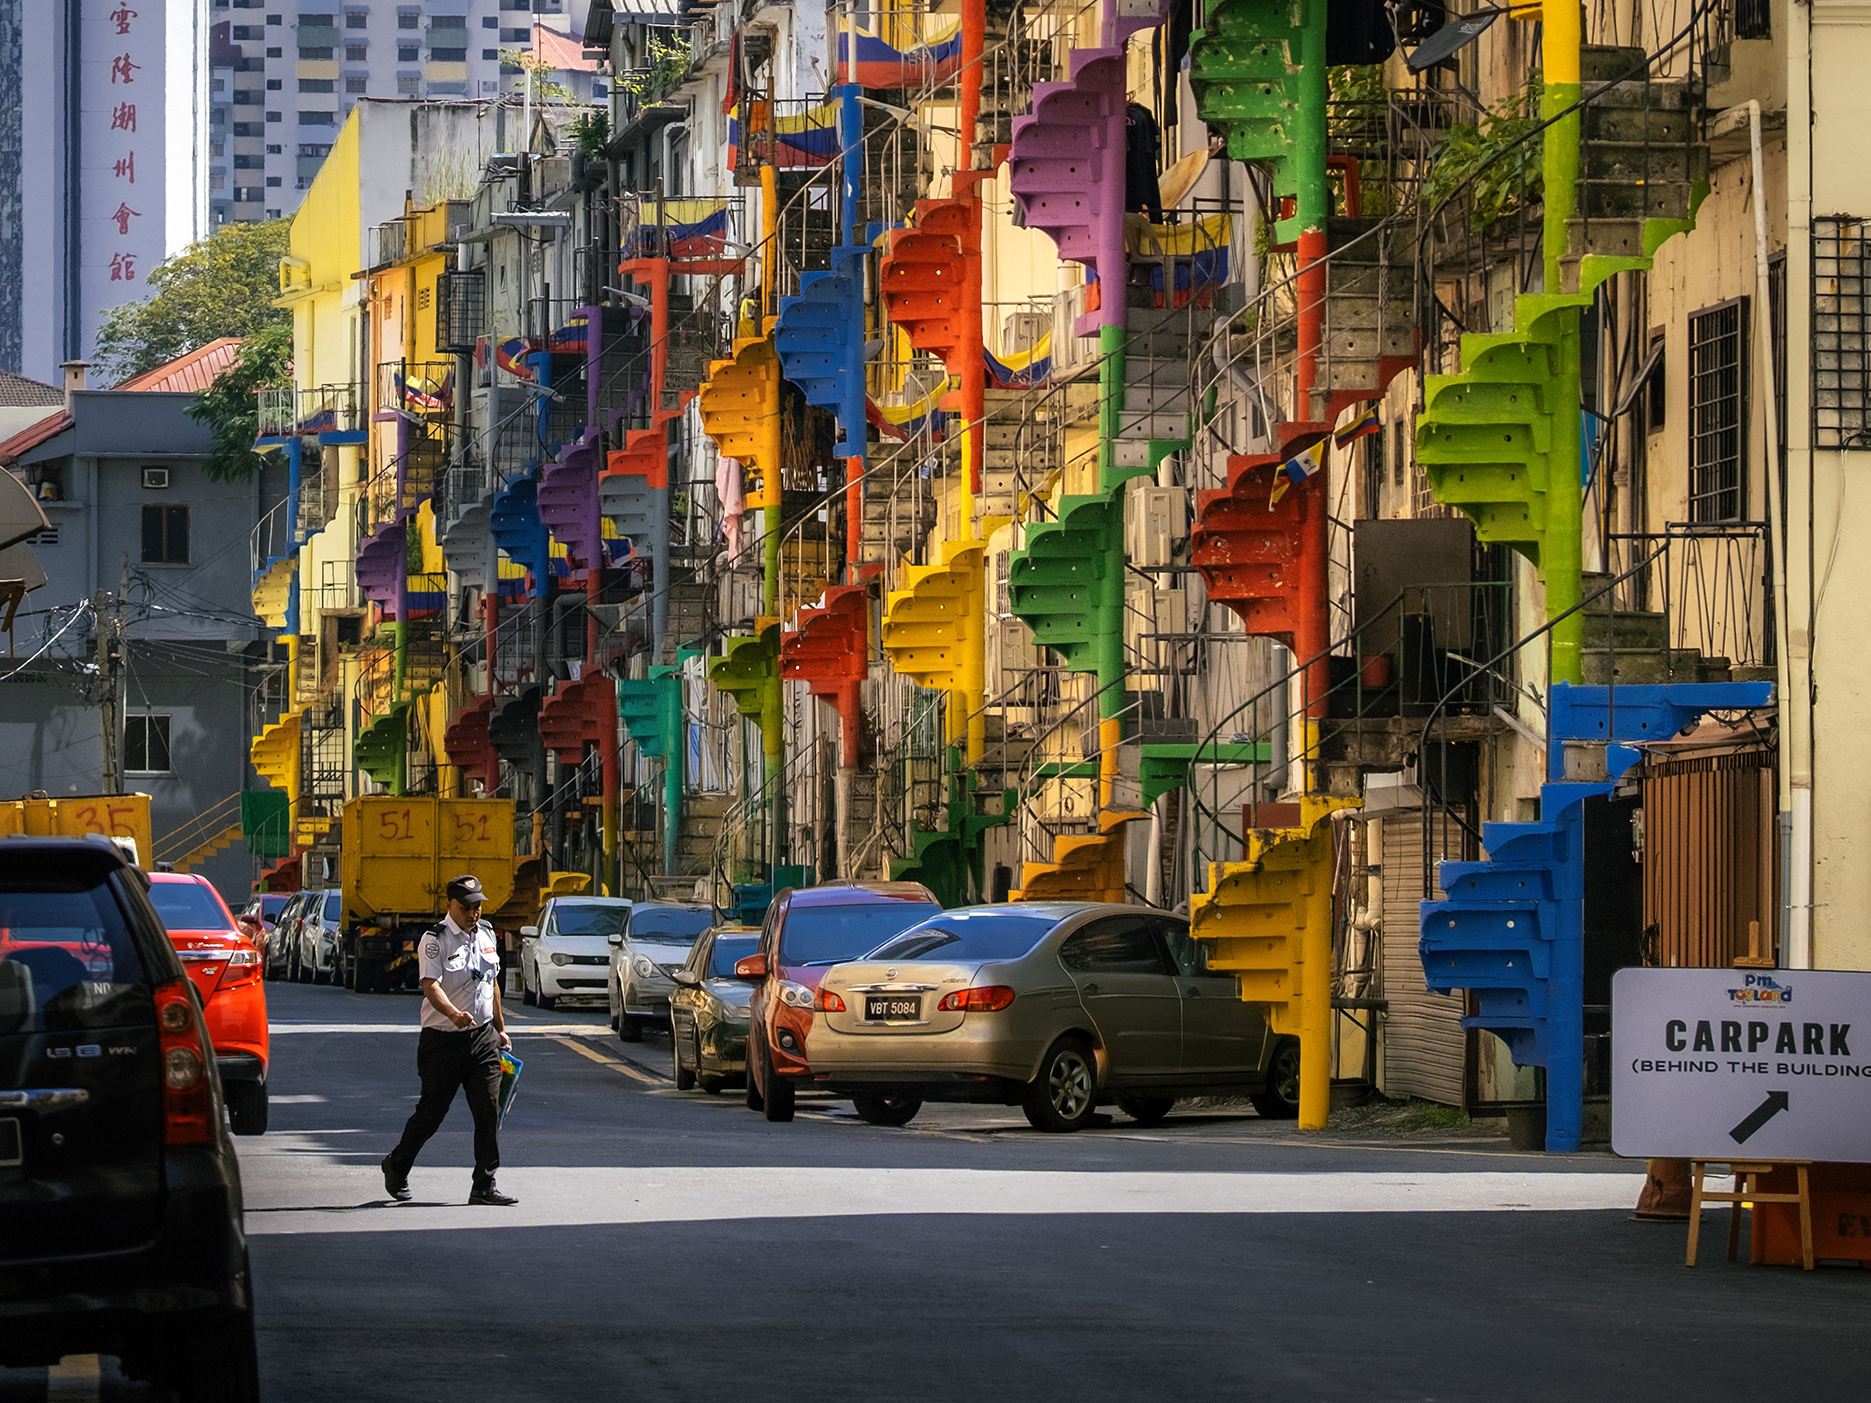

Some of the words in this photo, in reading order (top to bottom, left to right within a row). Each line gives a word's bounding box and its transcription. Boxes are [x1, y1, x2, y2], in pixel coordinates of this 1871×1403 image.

[109, 1, 142, 281] 雪隆潮州會館
[76, 807, 135, 837] 35
[380, 809, 414, 841] 51
[454, 813, 491, 842] 51
[870, 1002, 888, 1014] VBT
[890, 1002, 916, 1014] 5084
[1665, 1019, 1851, 1056] CARPARK
[1632, 1058, 1718, 1074] (BEHIND
[1727, 1061, 1769, 1074] THE
